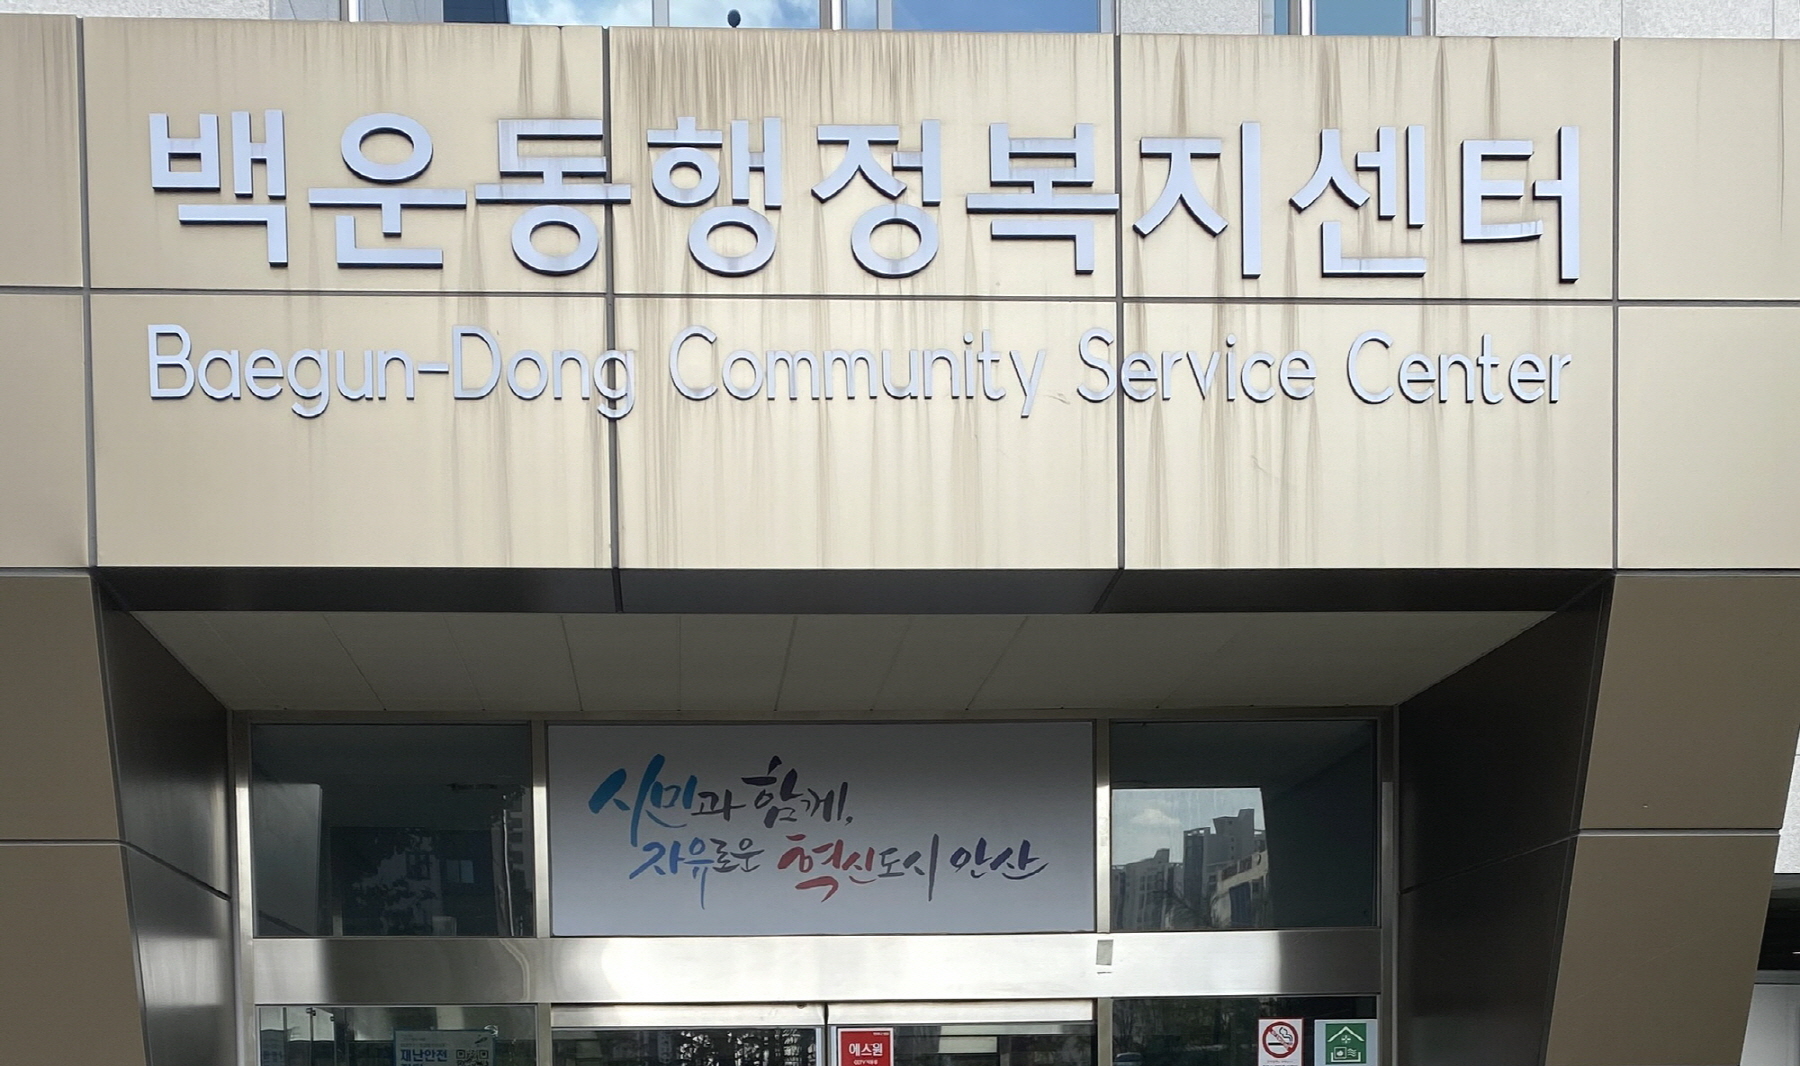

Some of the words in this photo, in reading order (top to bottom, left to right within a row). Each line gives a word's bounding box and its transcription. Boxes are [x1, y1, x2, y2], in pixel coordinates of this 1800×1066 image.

[149, 109, 1580, 284] 백운동행정복지센터
[148, 324, 636, 421] Baegun-Dong
[669, 324, 1047, 419] Community
[1077, 327, 1318, 404] Service
[1347, 329, 1573, 405] Center
[588, 753, 746, 848] 시민과
[629, 836, 765, 910] 자유로운
[777, 833, 940, 903] 혁신도시
[949, 836, 1050, 880] 안산
[401, 1049, 447, 1062] 재난안전
[848, 1042, 883, 1057] 에스원
